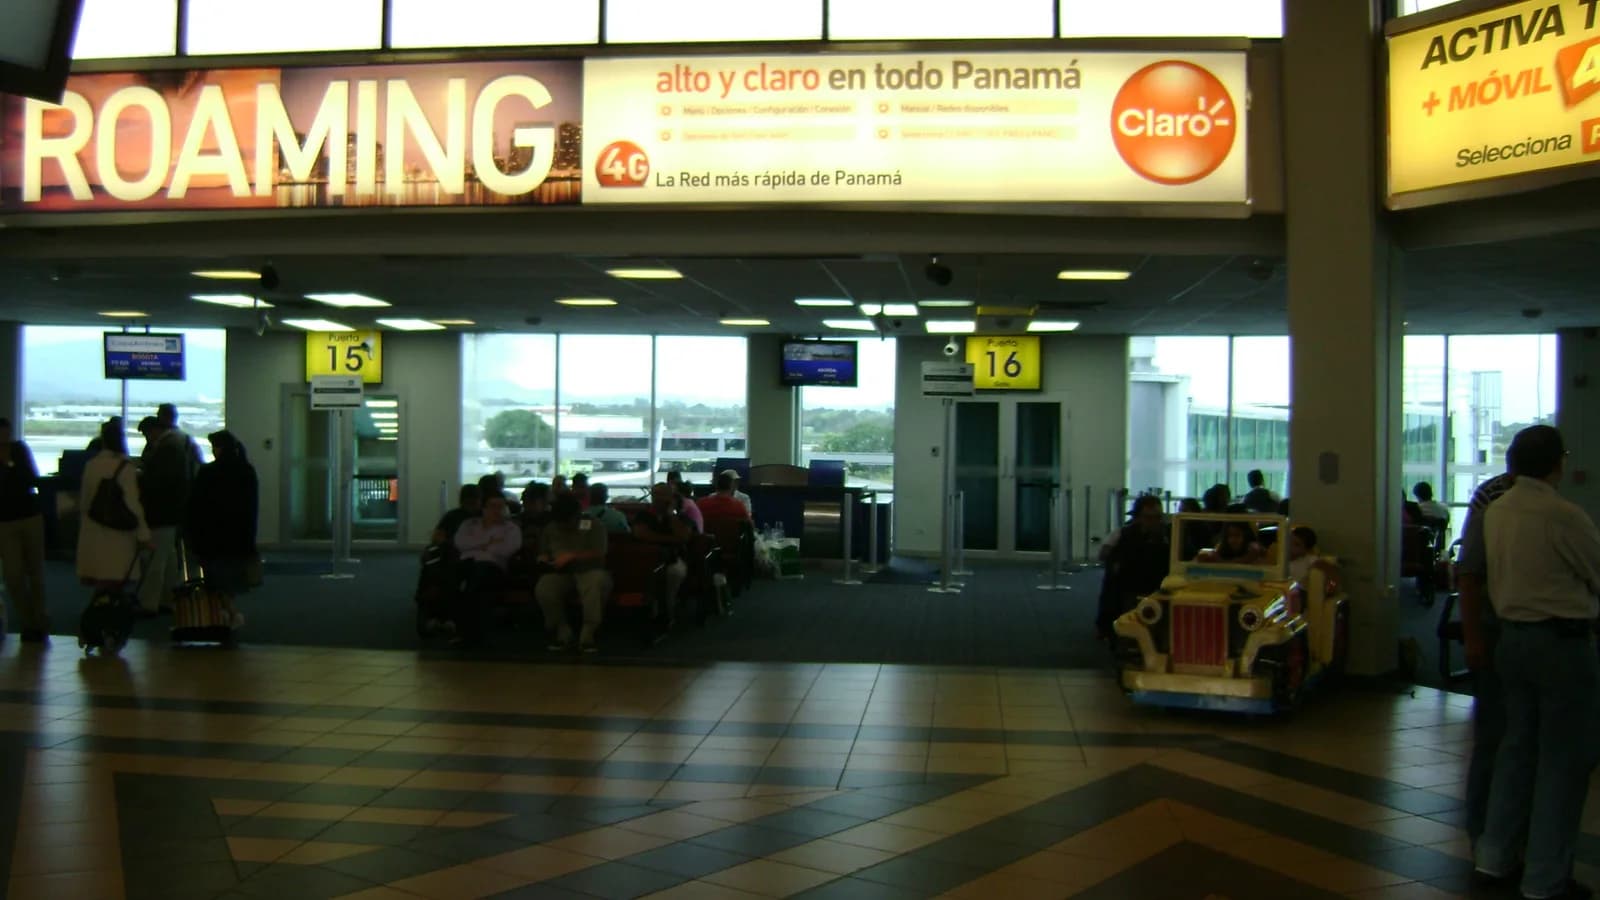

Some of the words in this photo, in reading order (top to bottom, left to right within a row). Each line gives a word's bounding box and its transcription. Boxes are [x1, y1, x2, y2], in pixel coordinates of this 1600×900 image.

[1420, 4, 1566, 70] ACTIVA
[656, 63, 711, 93] alto
[719, 70, 736, 98] y
[743, 62, 821, 92] claro
[828, 67, 866, 90] en
[874, 60, 944, 90] todo
[952, 58, 1082, 90] Panamá
[1448, 67, 1552, 112] MÓVIL
[23, 74, 556, 202] ROAMING
[1117, 108, 1212, 138] Claro
[601, 147, 650, 182] 4G
[1455, 133, 1573, 168] Selecciona
[656, 171, 675, 188] La
[680, 171, 710, 188] Red
[715, 170, 750, 187] más
[754, 170, 806, 190] rápida
[810, 170, 831, 186] de
[835, 169, 903, 187] Panamá
[327, 332, 360, 343] Puerta
[327, 345, 364, 372] 15
[985, 350, 1022, 378] 16
